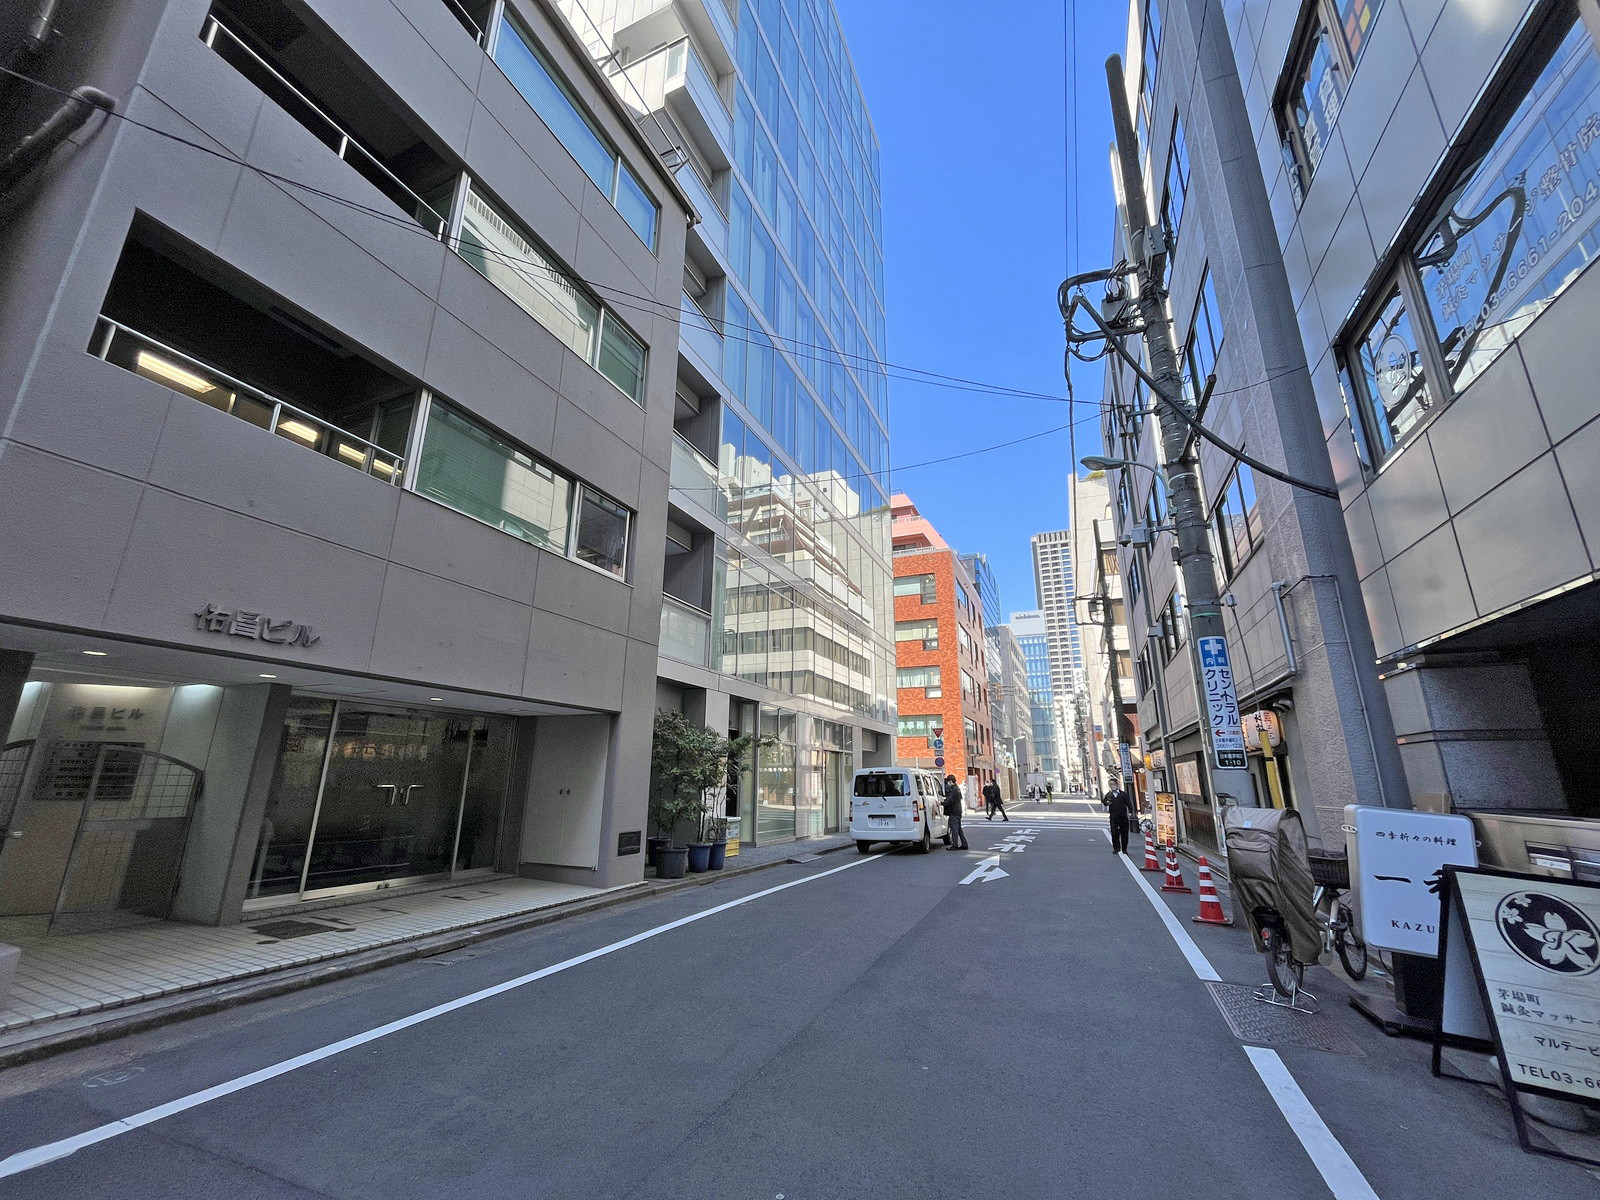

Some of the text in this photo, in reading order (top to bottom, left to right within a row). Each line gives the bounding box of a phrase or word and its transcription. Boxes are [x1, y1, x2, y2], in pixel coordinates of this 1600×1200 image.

[1205, 669, 1225, 726] クリニック
[1218, 668, 1239, 726] セントラル
[1375, 828, 1458, 847] 四季折々の料理
[1391, 919, 1436, 934] KAZU
